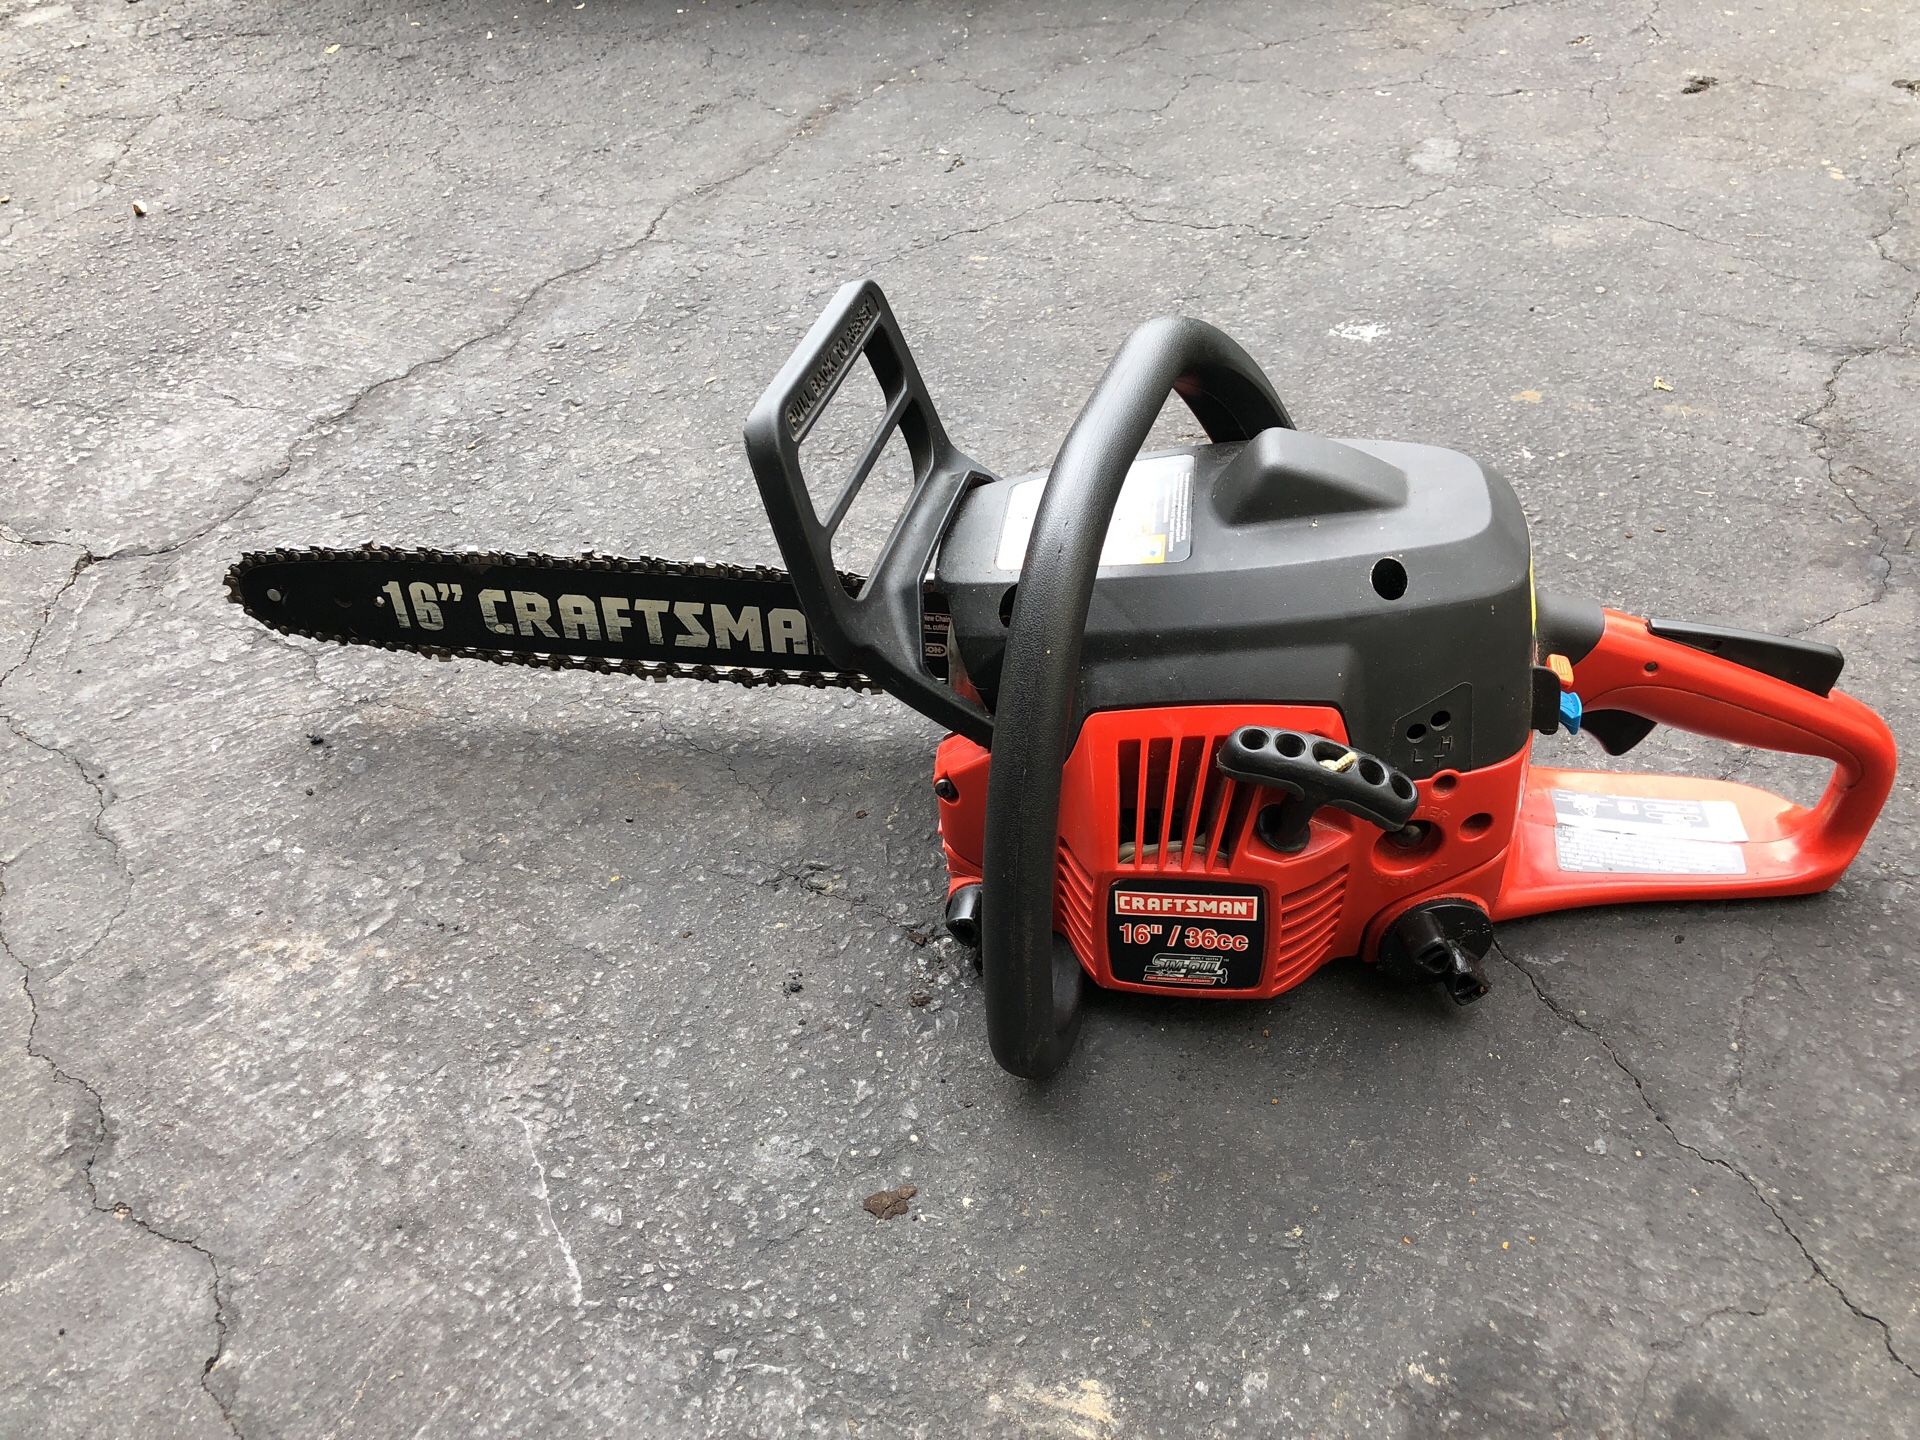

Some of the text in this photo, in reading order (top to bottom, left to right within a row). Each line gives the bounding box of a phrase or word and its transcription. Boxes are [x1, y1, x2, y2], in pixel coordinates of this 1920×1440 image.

[478, 588, 824, 656] CRAFTSMA
[1413, 748, 1424, 763] L
[1119, 896, 1247, 915] CRAFTSMAN
[1166, 924, 1182, 947] /
[1184, 926, 1249, 952] 36cc
